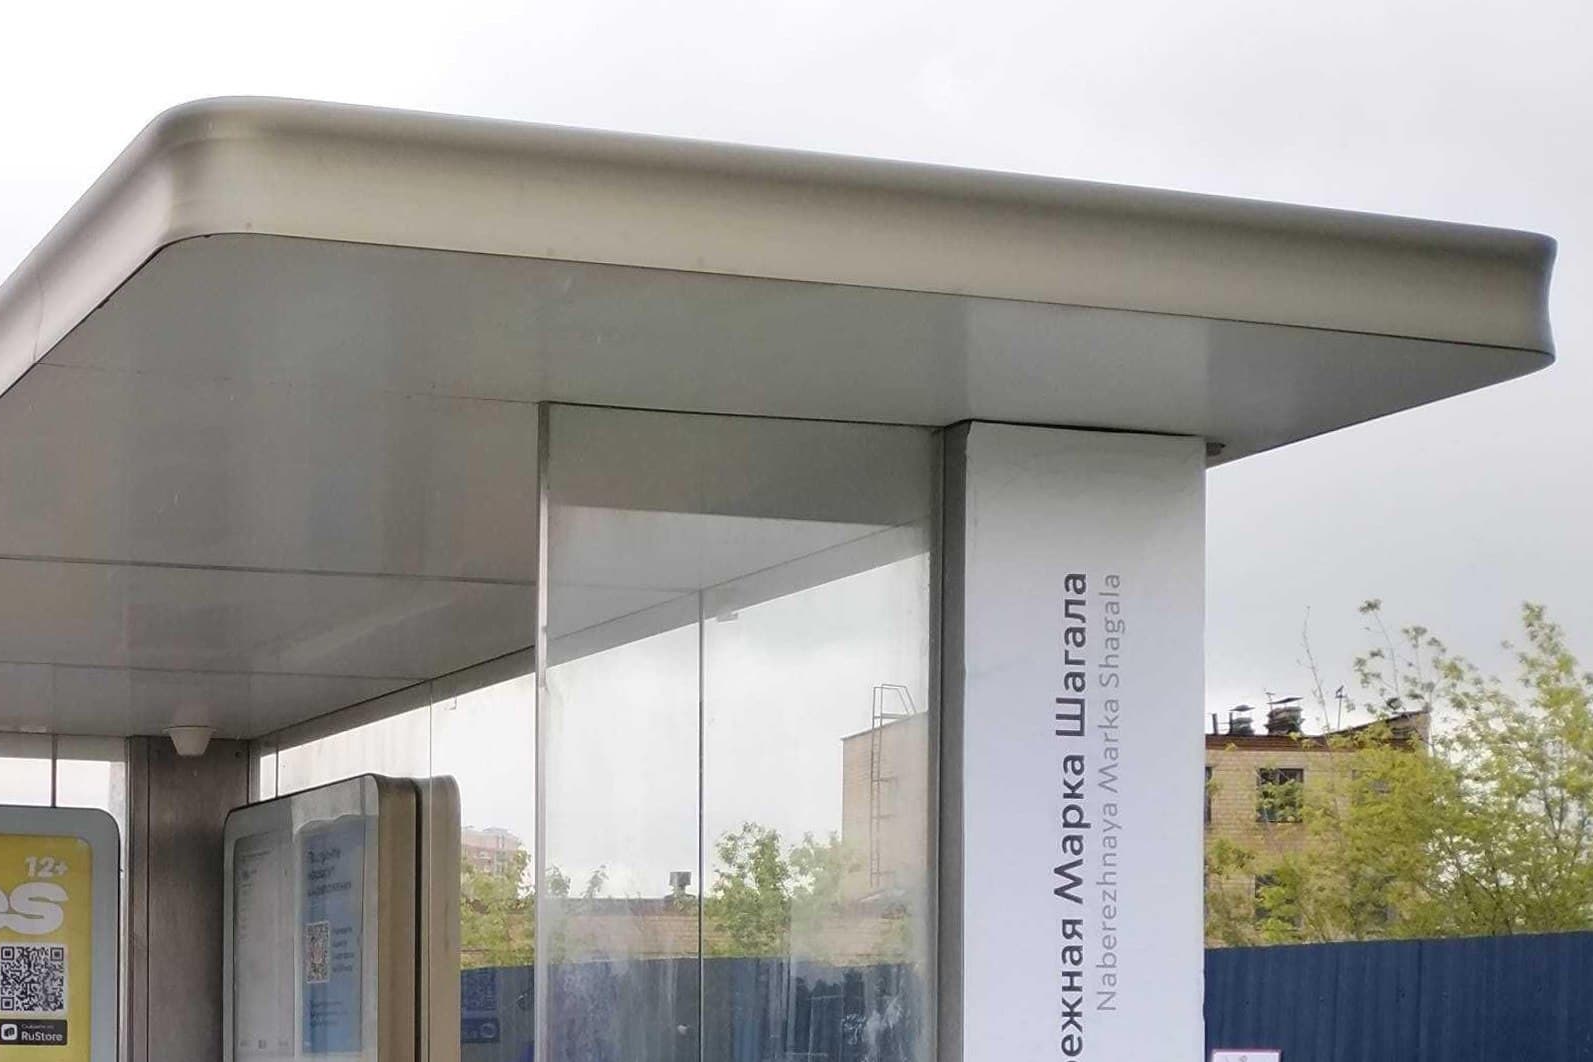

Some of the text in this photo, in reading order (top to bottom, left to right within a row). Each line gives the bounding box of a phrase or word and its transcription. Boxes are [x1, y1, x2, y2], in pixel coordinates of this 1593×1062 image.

[1055, 572, 1087, 737] Шагала
[25, 856, 68, 878] 12+
[1053, 754, 1092, 905] Марка
[1095, 574, 1125, 1011] Naberezhnaya Marka Shagala
[21, 1031, 64, 1042] RuStore
